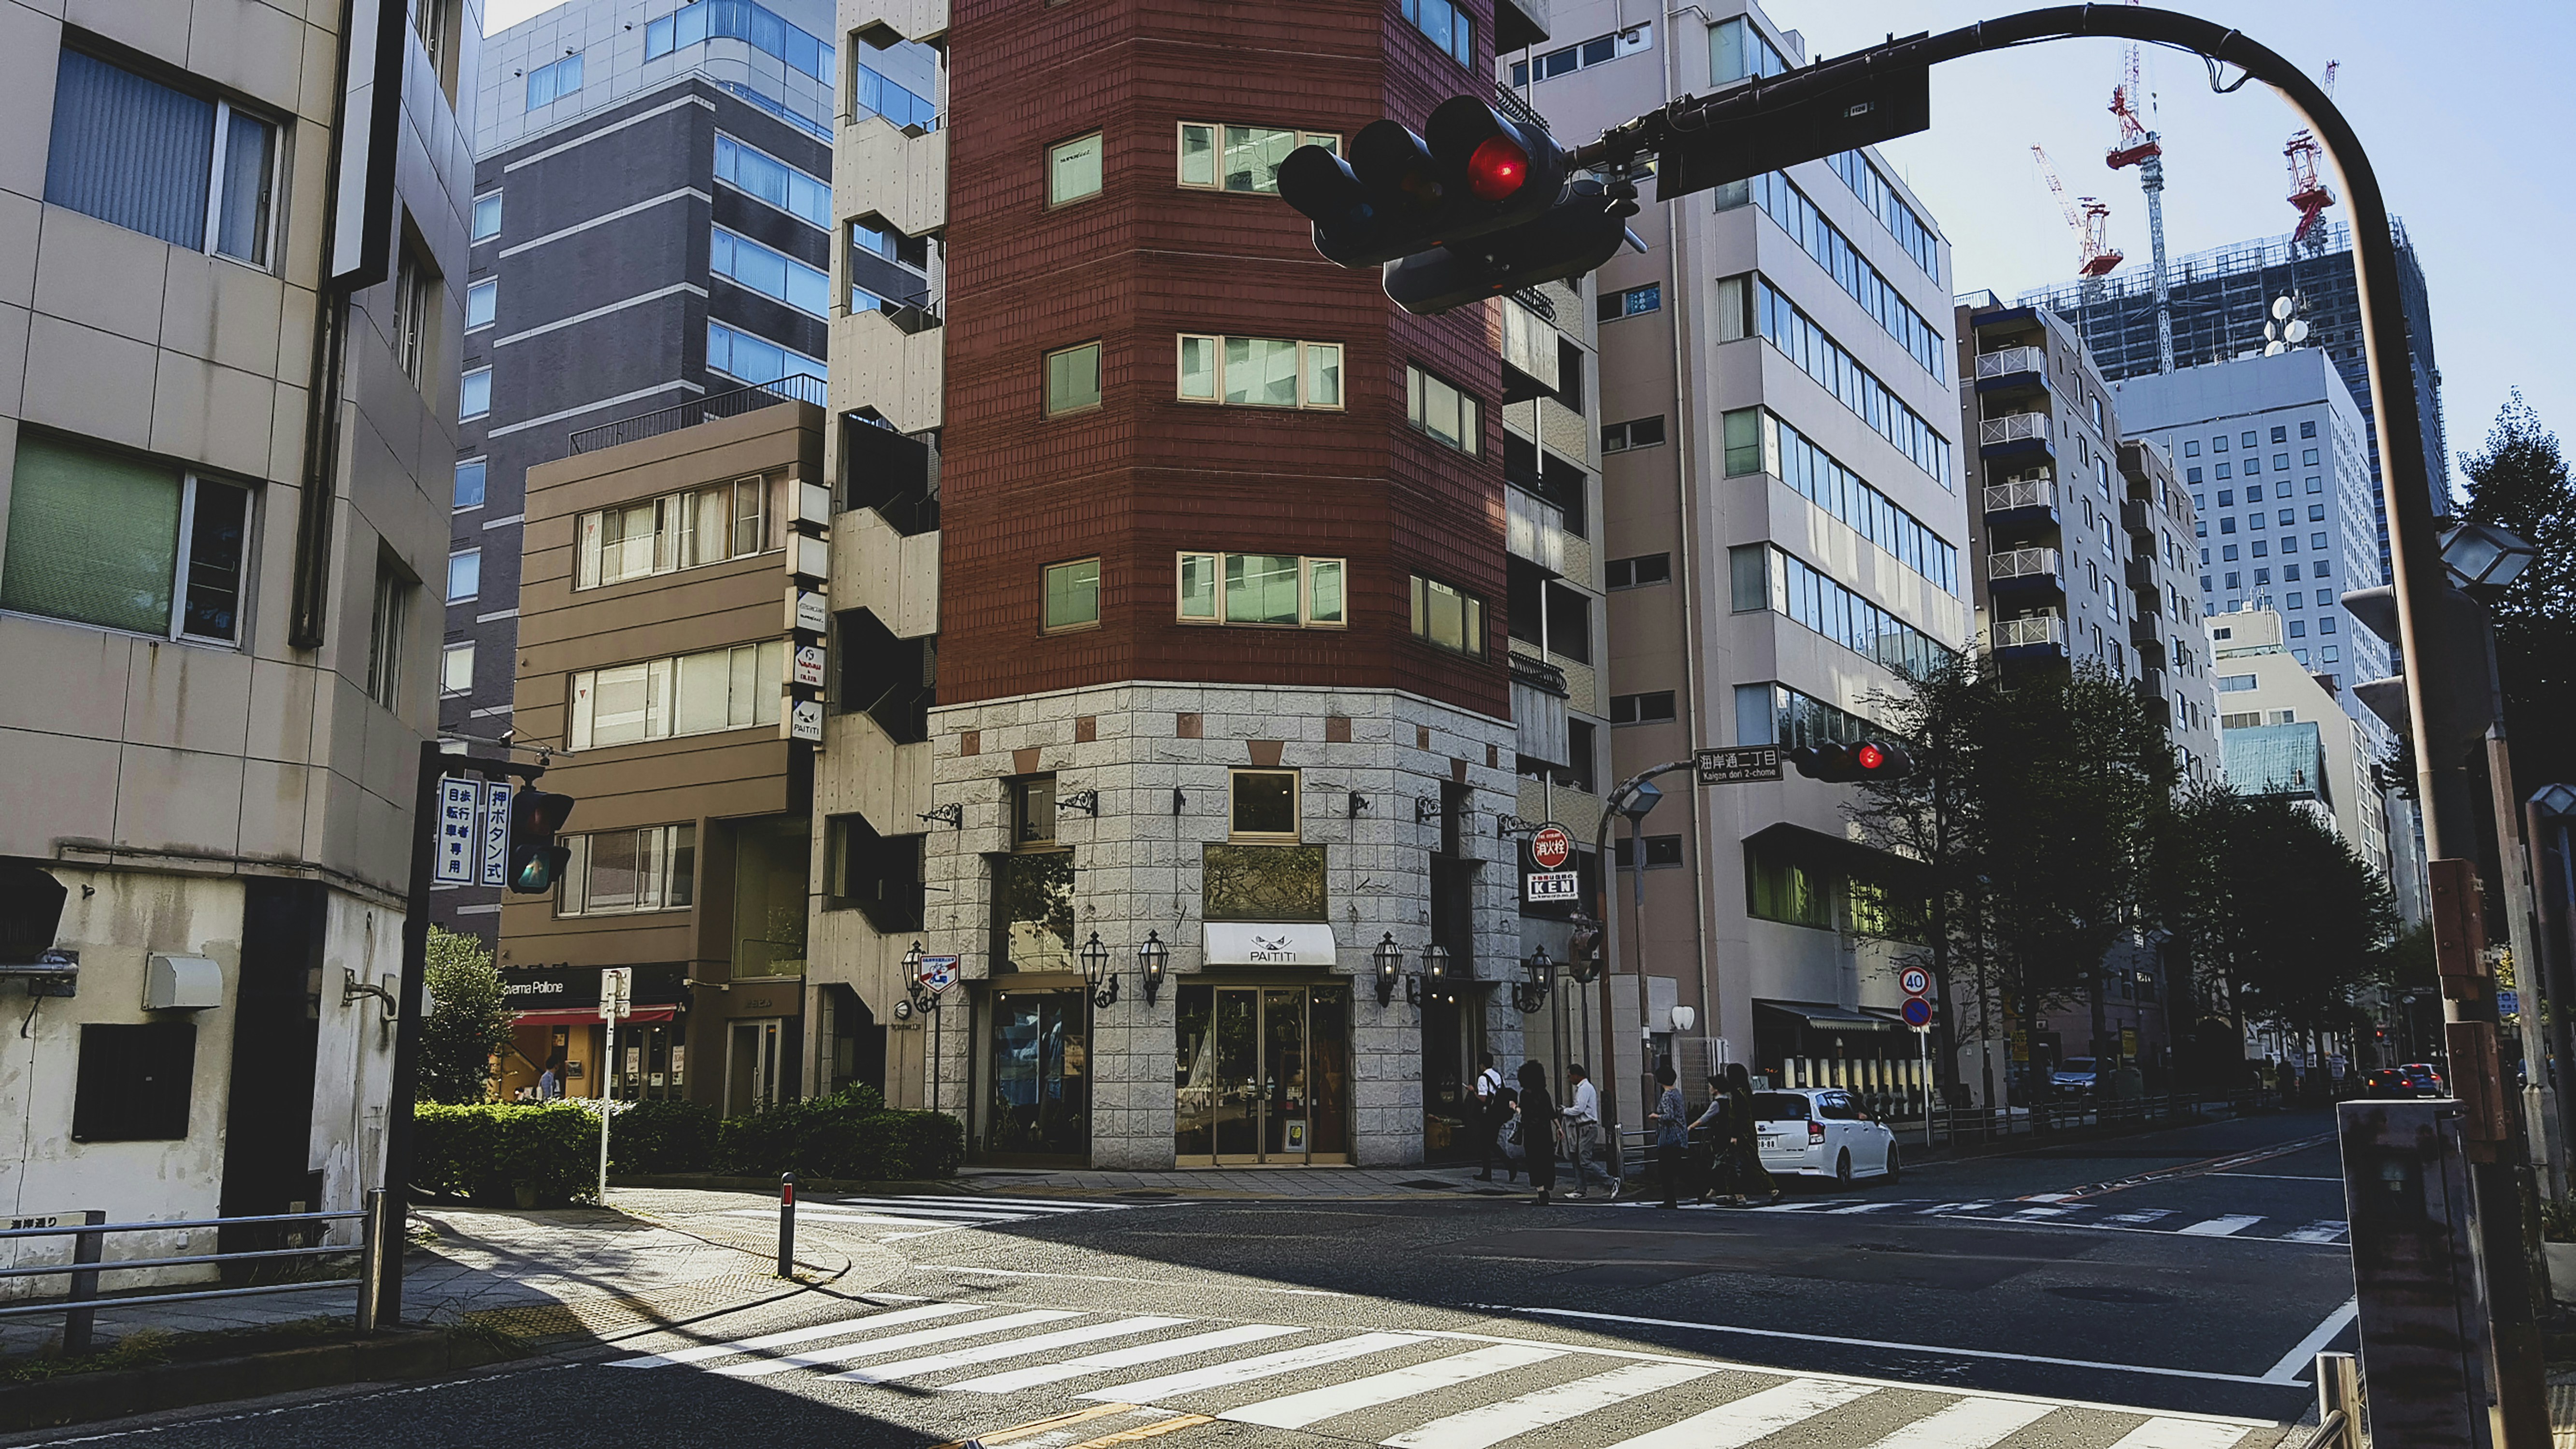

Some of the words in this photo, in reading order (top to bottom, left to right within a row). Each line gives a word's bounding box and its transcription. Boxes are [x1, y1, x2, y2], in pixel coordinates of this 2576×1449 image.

[794, 724, 819, 735] PAITITI
[1700, 750, 1776, 770] 海岸通二丁目
[1703, 771, 1726, 781] Kaigan
[1729, 768, 1742, 778] dori
[1744, 768, 1776, 777] 2-chome
[458, 789, 471, 838] 歩行者
[487, 791, 507, 878] 押ボタン式
[1536, 839, 1565, 857] 消火栓
[1534, 881, 1570, 893] KEN
[1250, 952, 1296, 962] PAITITI
[1906, 975, 1922, 988] 40
[10, 1217, 57, 1230] 海岸通り
